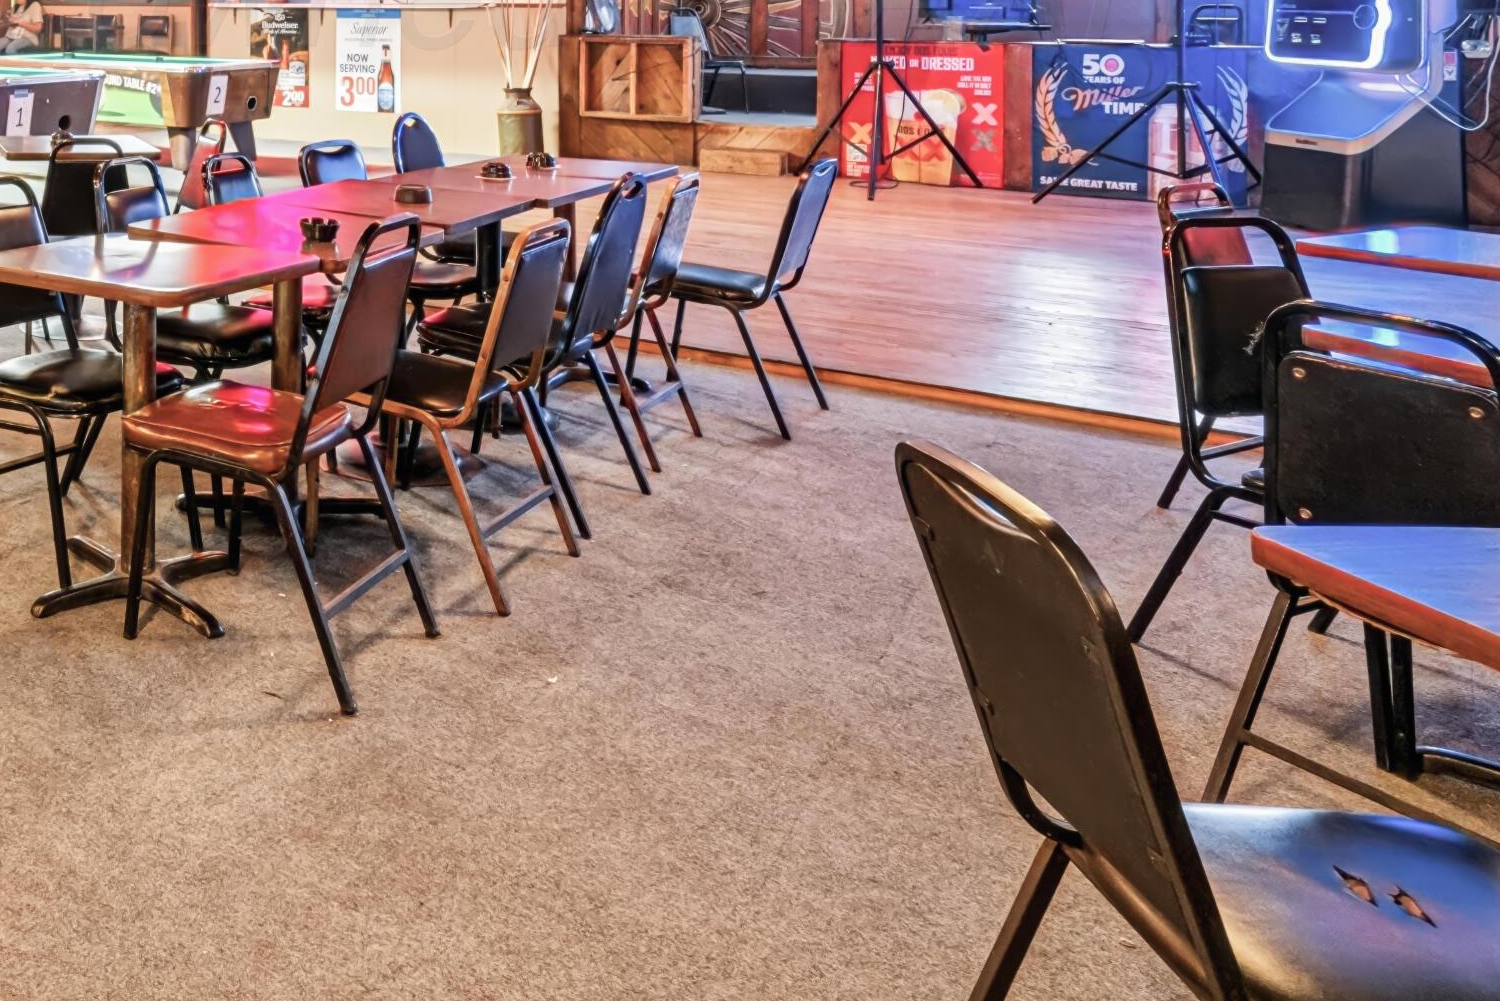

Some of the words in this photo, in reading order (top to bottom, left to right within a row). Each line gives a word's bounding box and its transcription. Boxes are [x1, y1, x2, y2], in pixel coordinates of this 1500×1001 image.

[261, 20, 299, 29] Budweiser
[350, 21, 388, 36] Superior
[346, 53, 369, 63] NOW
[909, 58, 920, 68] OR
[921, 57, 974, 71] DRESSED
[1082, 53, 1125, 76] 50
[339, 63, 376, 74] SERVING
[123, 76, 145, 91] TABLE
[146, 81, 158, 95] #2
[1083, 76, 1113, 84] YEARS
[1113, 76, 1125, 84] OF
[213, 86, 222, 104] 2
[1061, 86, 1145, 111] Miller
[15, 107, 24, 127] 1
[1040, 175, 1070, 186] SAE
[1070, 177, 1104, 189] GREAT
[1104, 179, 1138, 191] TASTE
